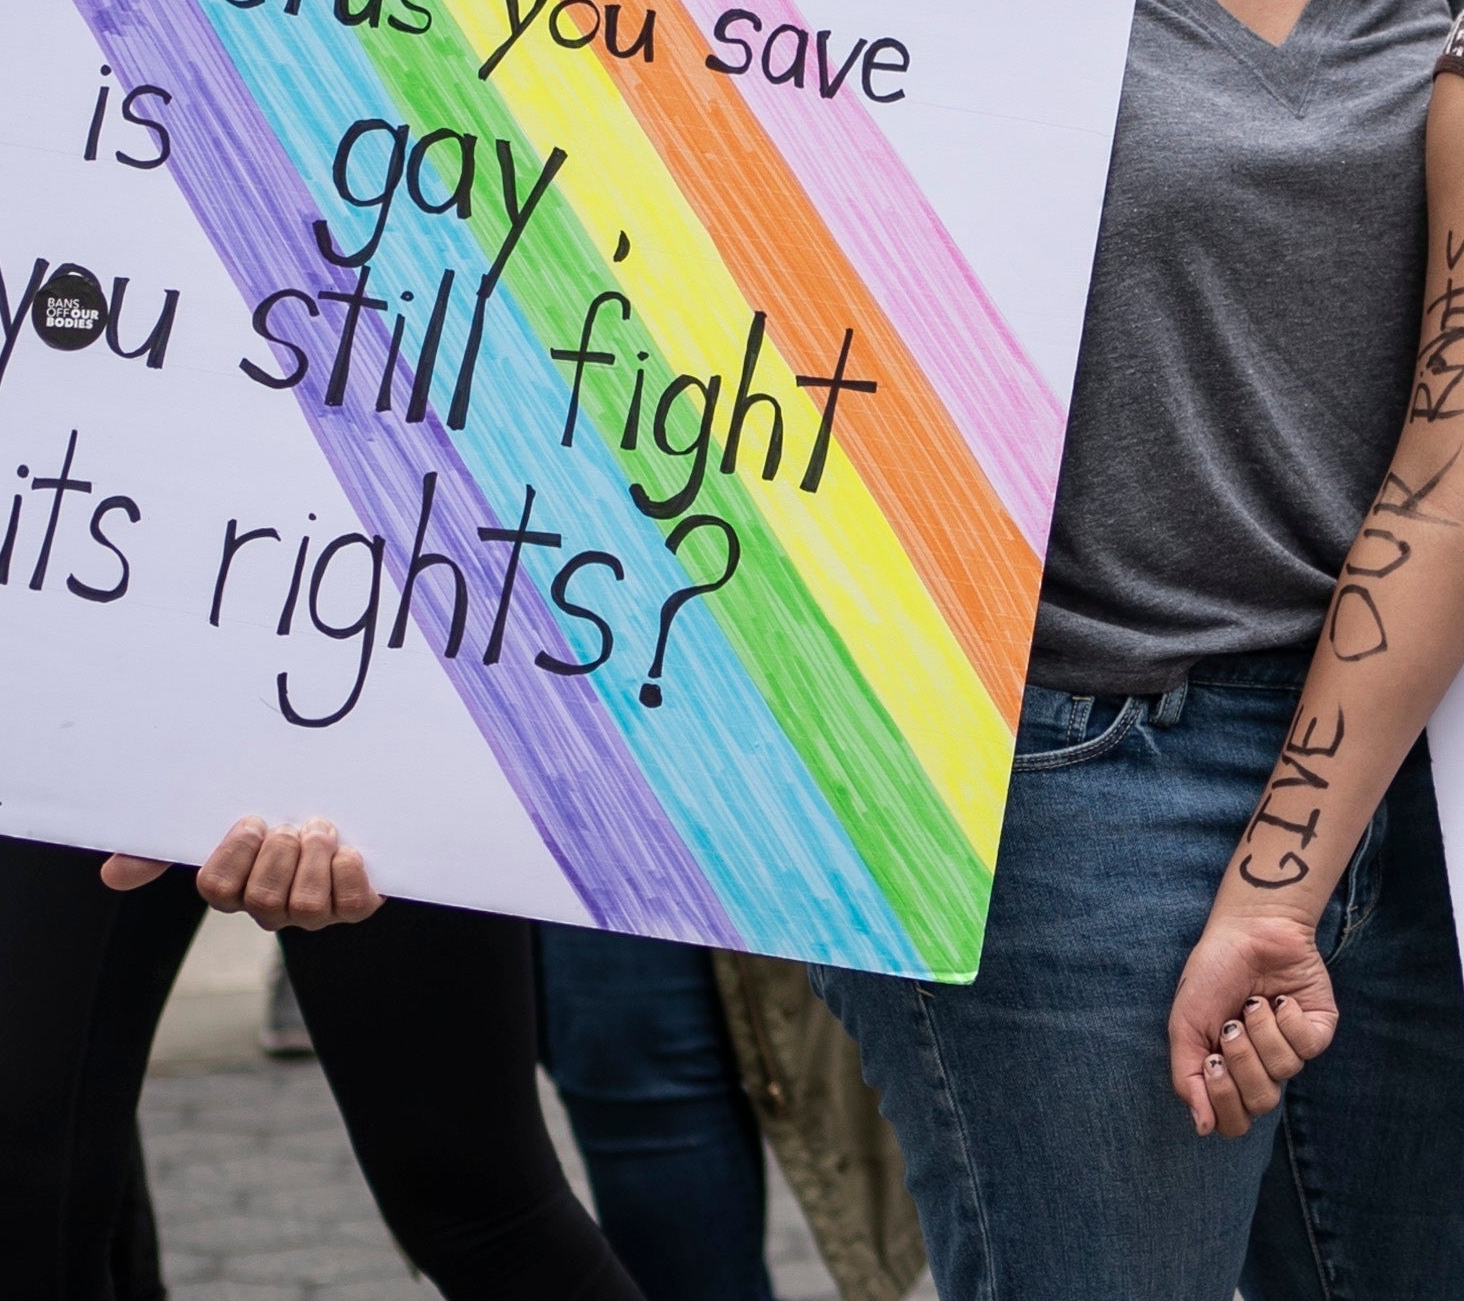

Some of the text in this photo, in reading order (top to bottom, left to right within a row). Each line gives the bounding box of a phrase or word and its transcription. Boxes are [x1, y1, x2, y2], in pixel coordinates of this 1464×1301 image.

[704, 8, 911, 104] save
[83, 63, 173, 170] is
[46, 308, 99, 320] OFF OUR
[46, 317, 94, 330] BODIES
[47, 297, 80, 309] BANS
[239, 266, 496, 431] still
[549, 291, 878, 521] fight
[209, 471, 742, 728] rights?
[1238, 702, 1346, 890] GIVE
[1329, 441, 1464, 663] OUR
